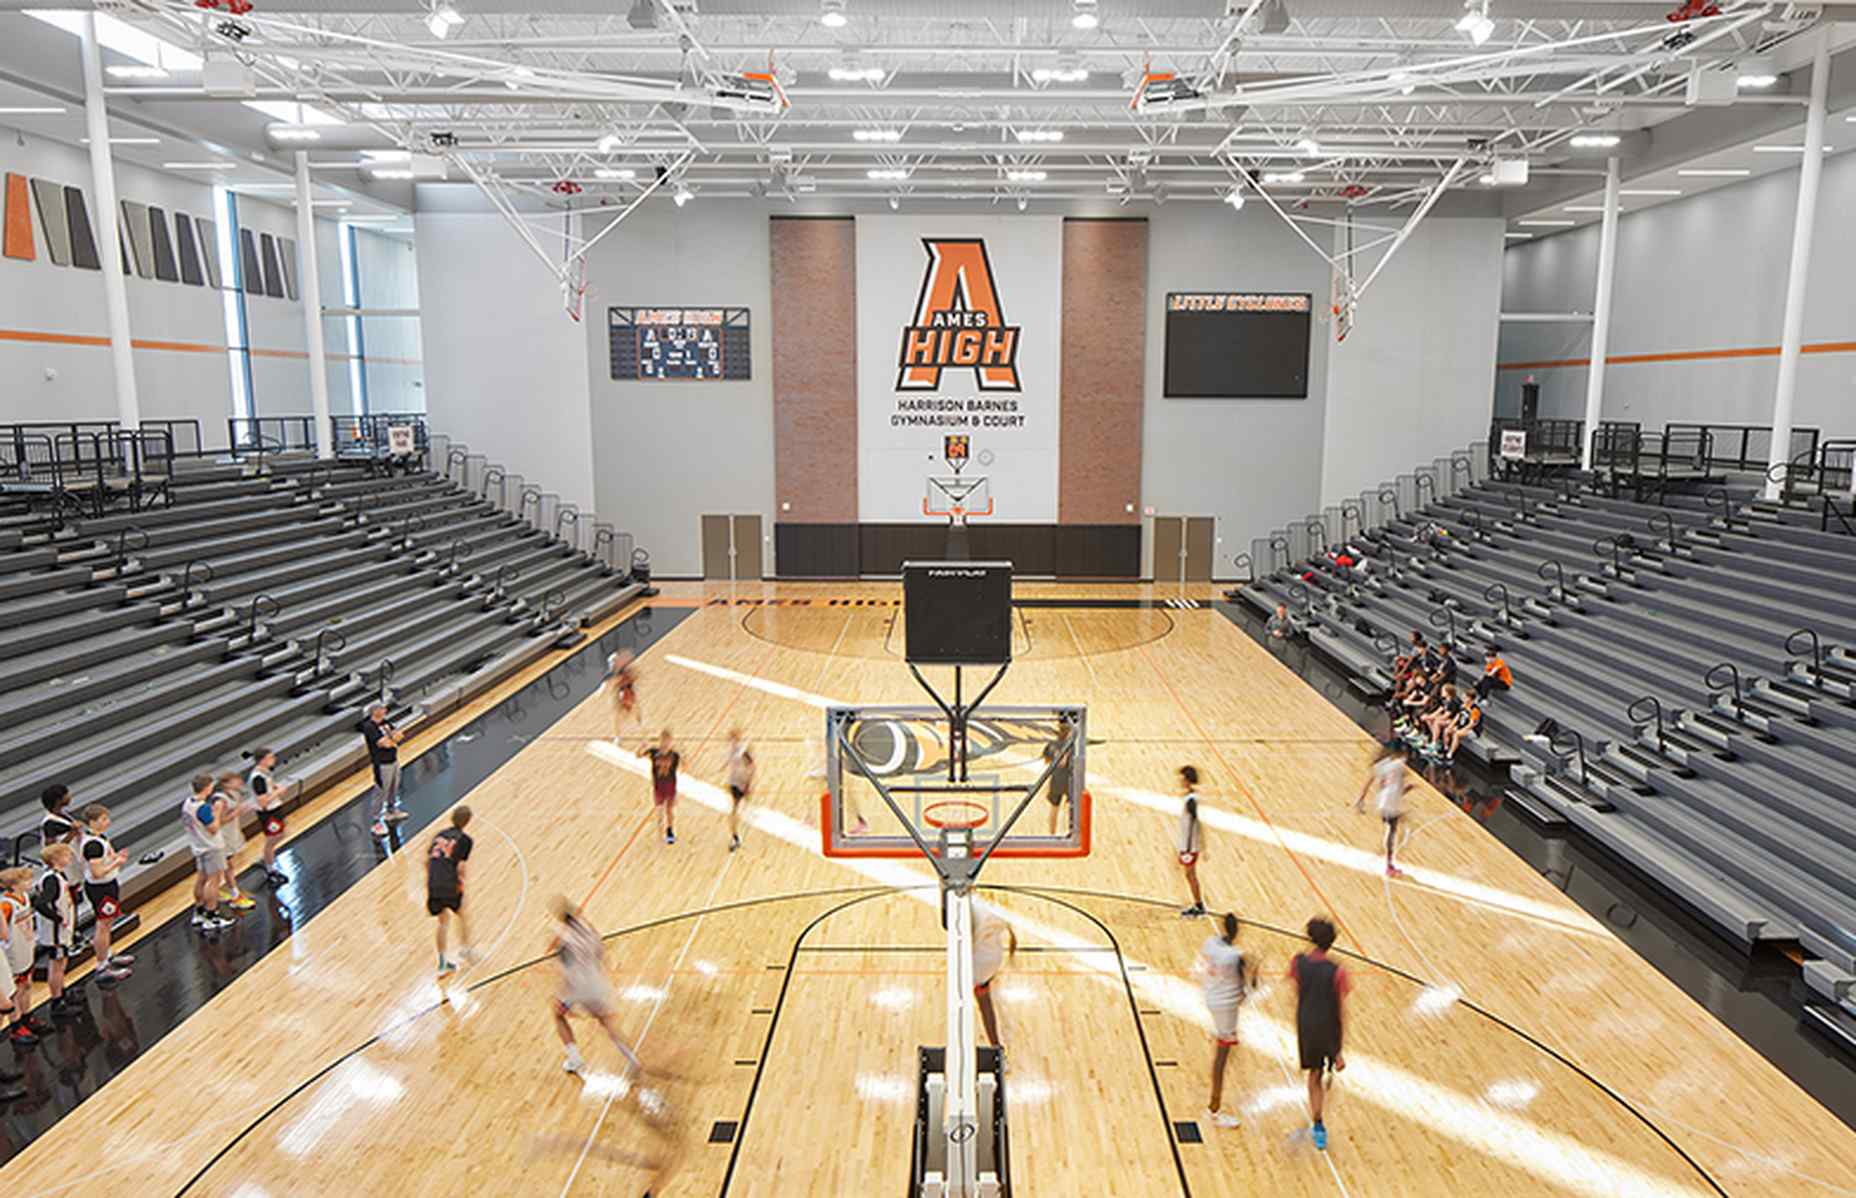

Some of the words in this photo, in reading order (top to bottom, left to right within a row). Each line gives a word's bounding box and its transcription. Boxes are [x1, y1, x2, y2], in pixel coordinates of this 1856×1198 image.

[932, 311, 988, 328] AMES
[902, 328, 1018, 366] HIGH
[898, 400, 963, 411] HARRISON
[966, 400, 1018, 411] BARNES
[890, 415, 968, 426] GYMNASIUM
[971, 415, 981, 427] &
[983, 415, 1025, 427] COURT
